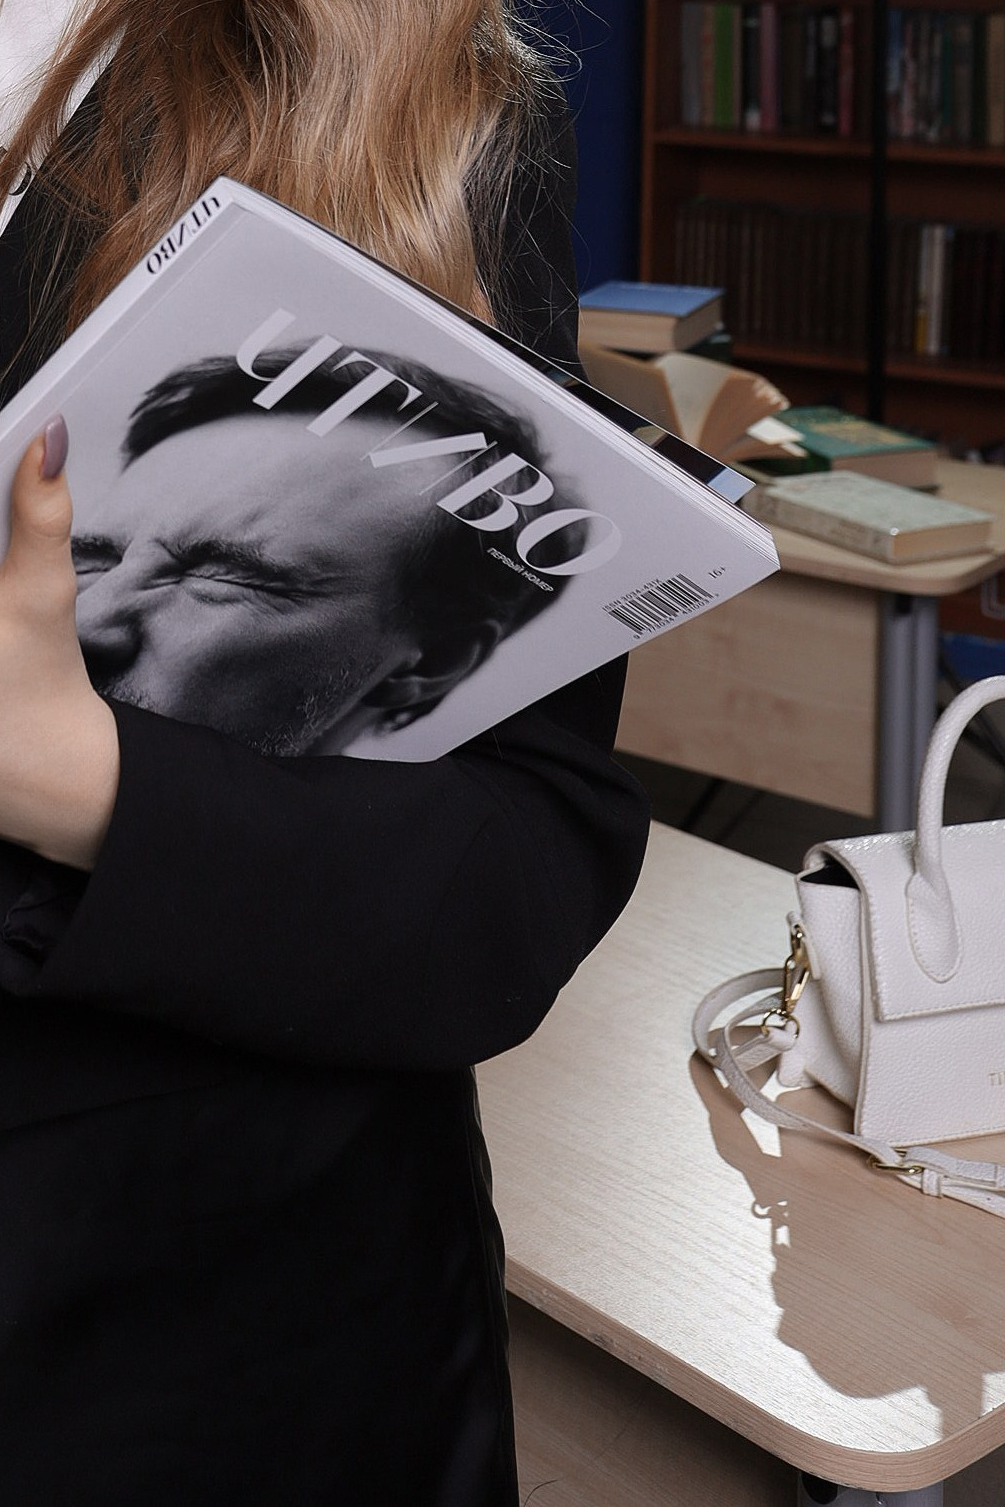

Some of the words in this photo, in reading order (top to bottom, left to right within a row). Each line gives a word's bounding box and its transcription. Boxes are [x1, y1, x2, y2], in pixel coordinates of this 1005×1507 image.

[146, 196, 221, 275] ЧТИВО
[235, 307, 623, 576] ЧТИВО
[486, 547, 525, 574] ПЕРВЫЙ
[521, 569, 555, 593] НОМЕР
